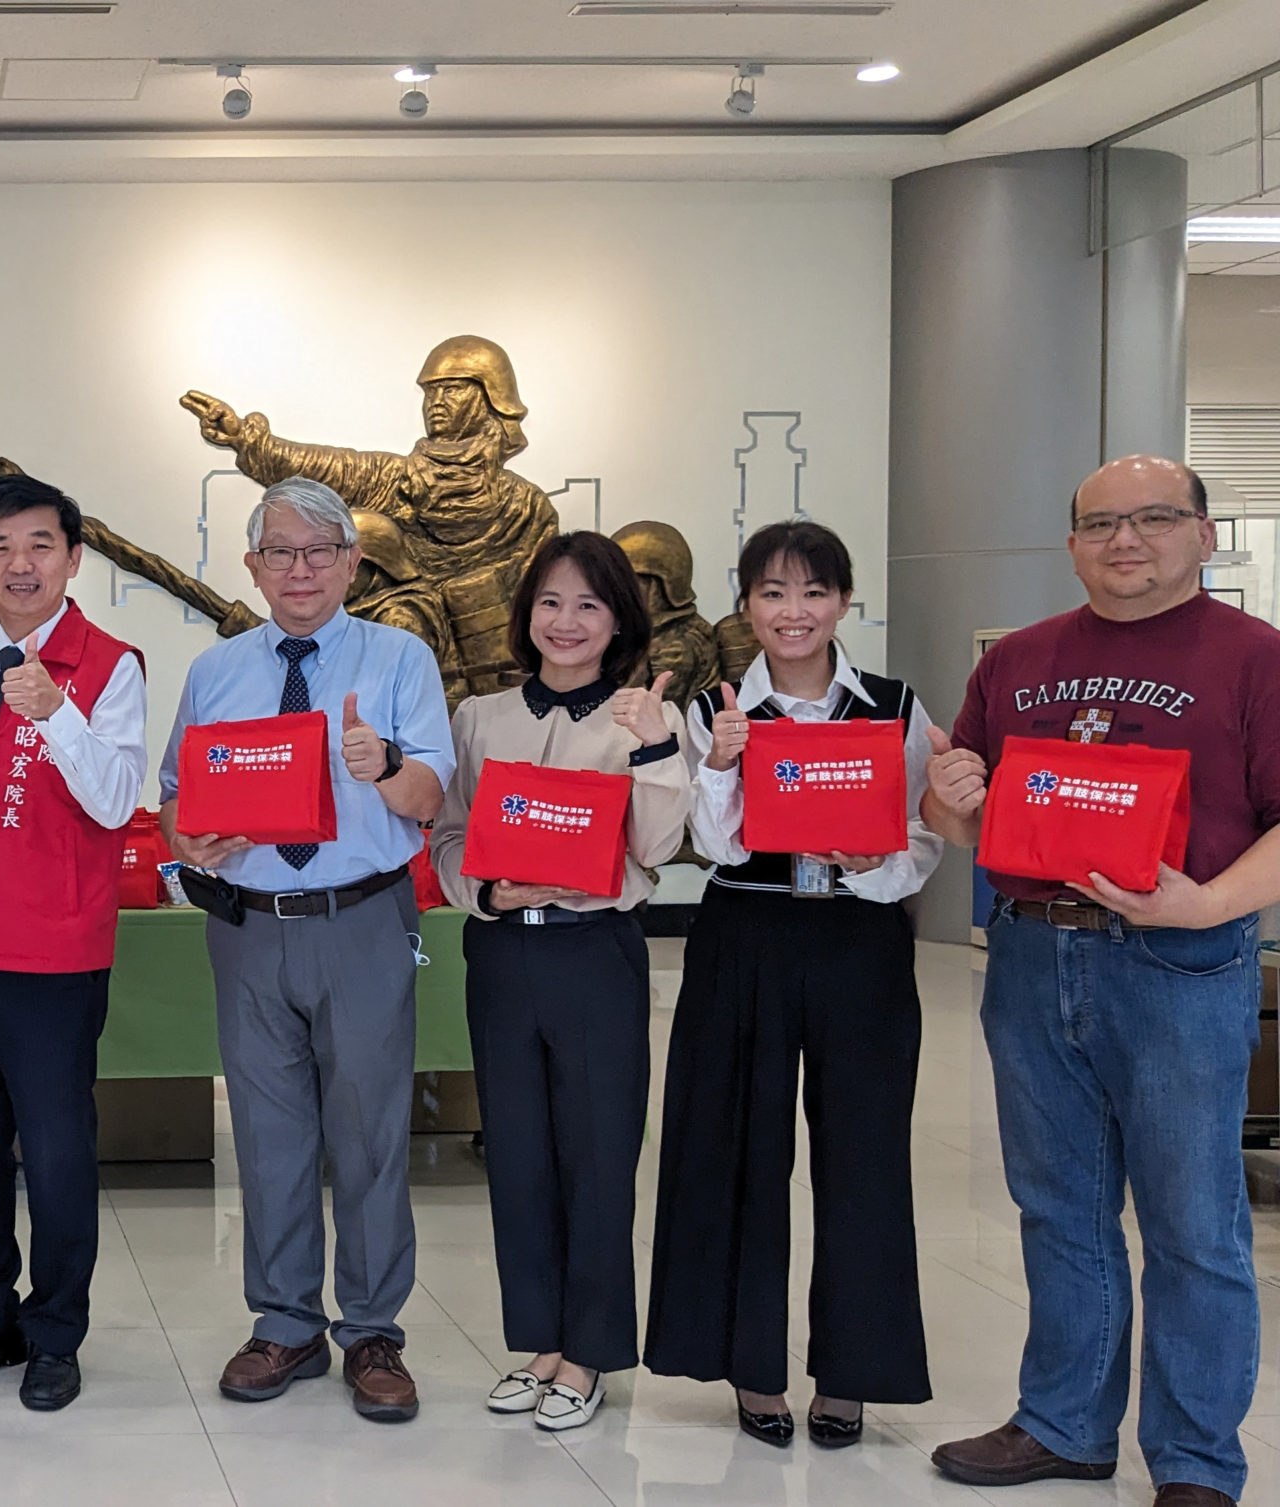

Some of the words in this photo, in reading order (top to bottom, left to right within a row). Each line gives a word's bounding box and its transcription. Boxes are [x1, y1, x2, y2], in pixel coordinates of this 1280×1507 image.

[1014, 676, 1195, 717] CAMBRIDGE
[1, 713, 41, 828] 昭宏院長
[209, 765, 228, 774] 119
[804, 769, 873, 782] 斷肢保冰袋
[779, 784, 800, 792] 119
[1026, 794, 1050, 805] 119
[1058, 785, 1136, 806] 斷肢保冰袋
[501, 815, 522, 825] 119
[528, 809, 591, 827] 斷肢保冰袋
